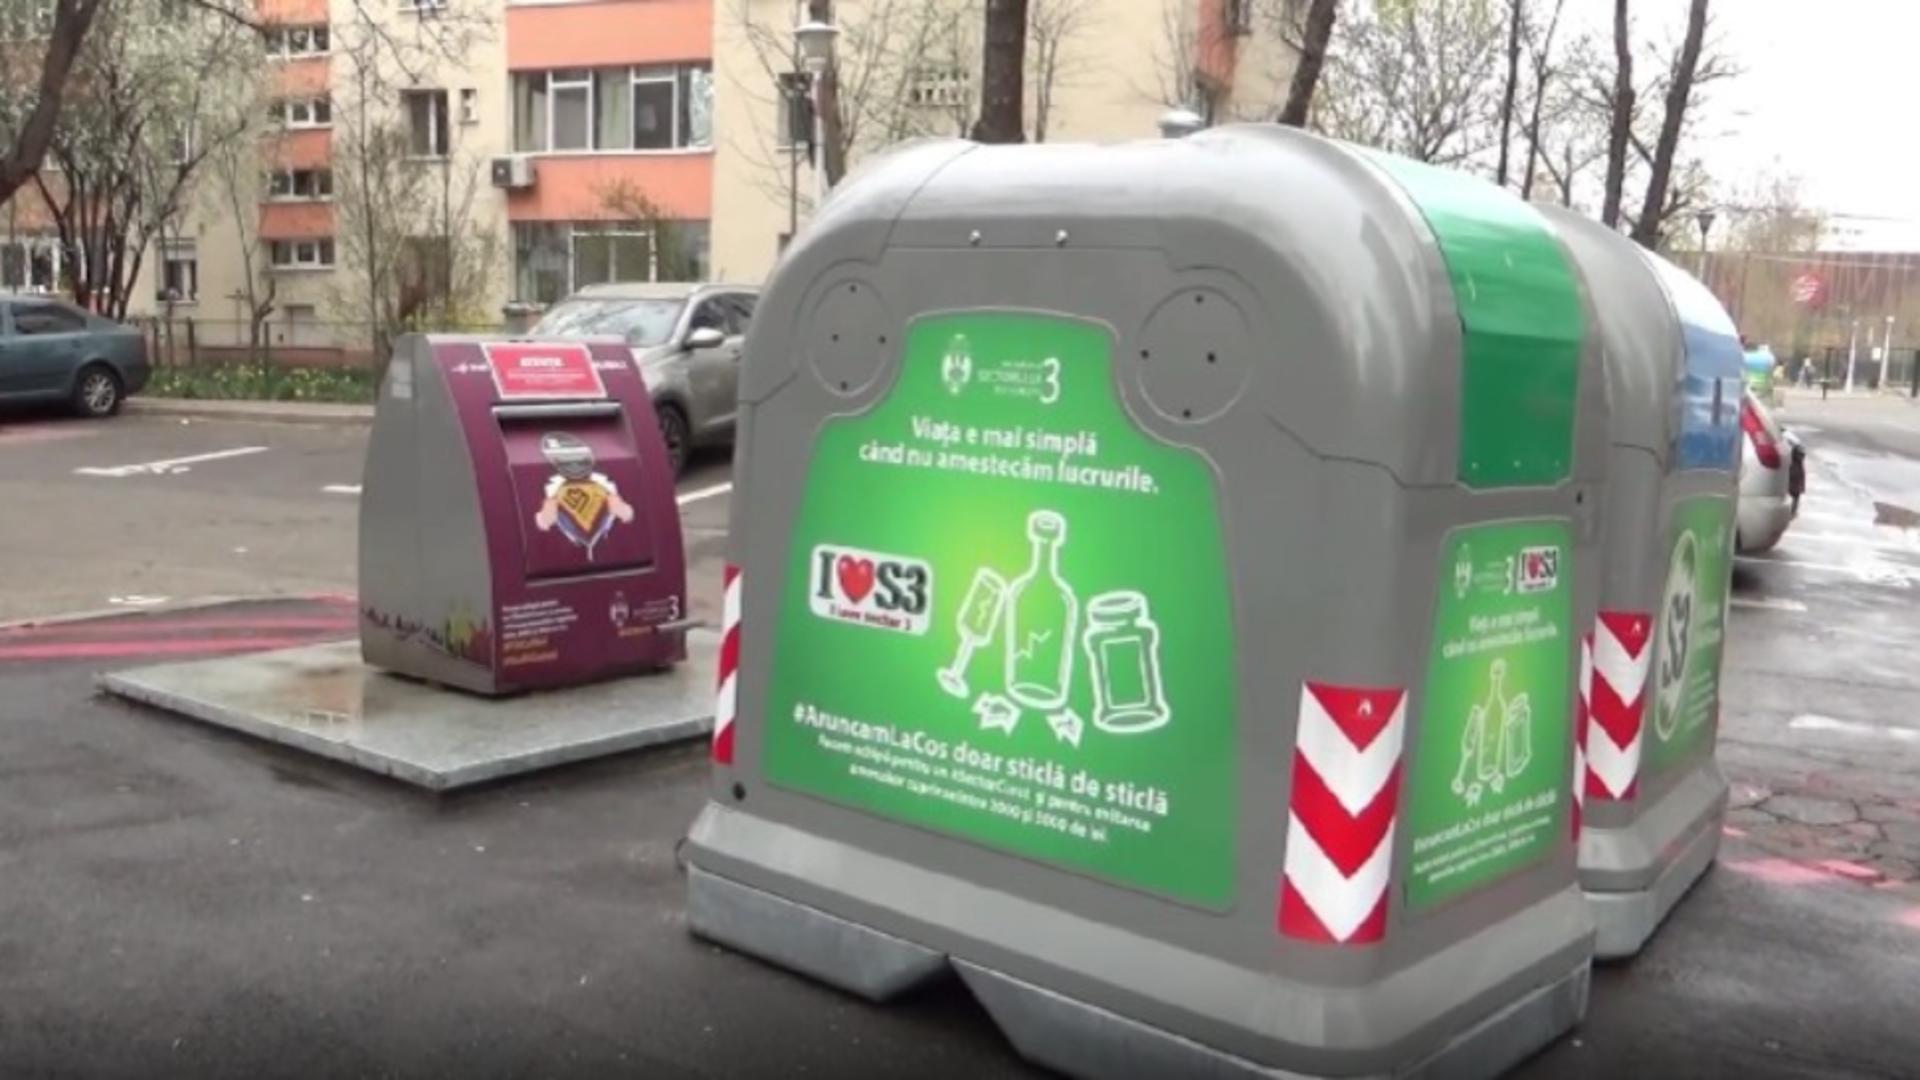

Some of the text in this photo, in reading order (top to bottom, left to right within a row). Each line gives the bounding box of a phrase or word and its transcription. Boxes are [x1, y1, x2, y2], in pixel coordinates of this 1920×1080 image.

[1040, 357, 1061, 404] 3
[906, 448, 933, 468] nu
[965, 427, 979, 445] e
[982, 426, 1022, 449] mai
[817, 551, 927, 615] I S3
[952, 741, 1004, 773] doar
[1070, 769, 1101, 799] de
